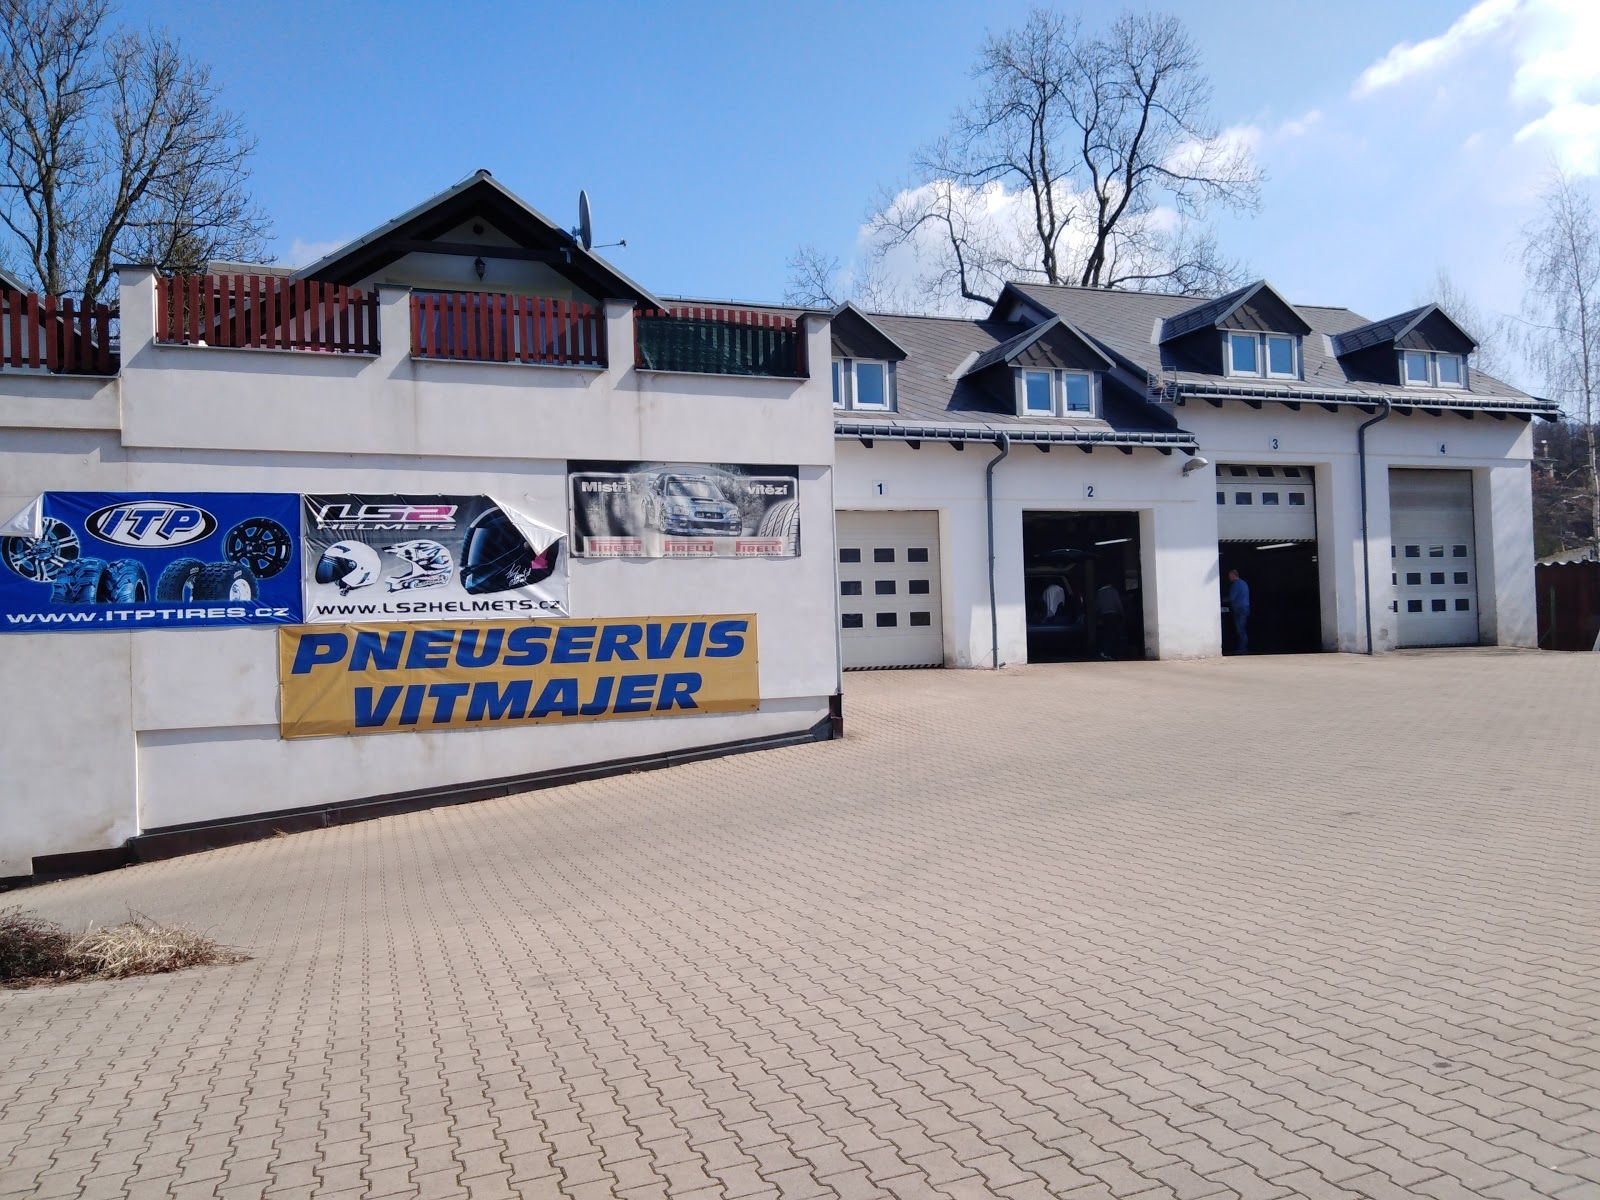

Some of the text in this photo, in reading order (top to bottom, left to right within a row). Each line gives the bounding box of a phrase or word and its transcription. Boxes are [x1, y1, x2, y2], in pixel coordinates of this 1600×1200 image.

[1272, 438, 1279, 450] 3
[1439, 444, 1446, 455] 4
[876, 482, 883, 496] 1
[1087, 485, 1094, 498] 2
[318, 503, 459, 523] LS2
[100, 507, 203, 540] ITP
[316, 523, 457, 531] HELMETS
[664, 540, 714, 553] PIRELLI
[735, 540, 782, 553] PIRELLI
[290, 620, 748, 675] PNEUSERVIS
[354, 672, 703, 728] VITMAJER
